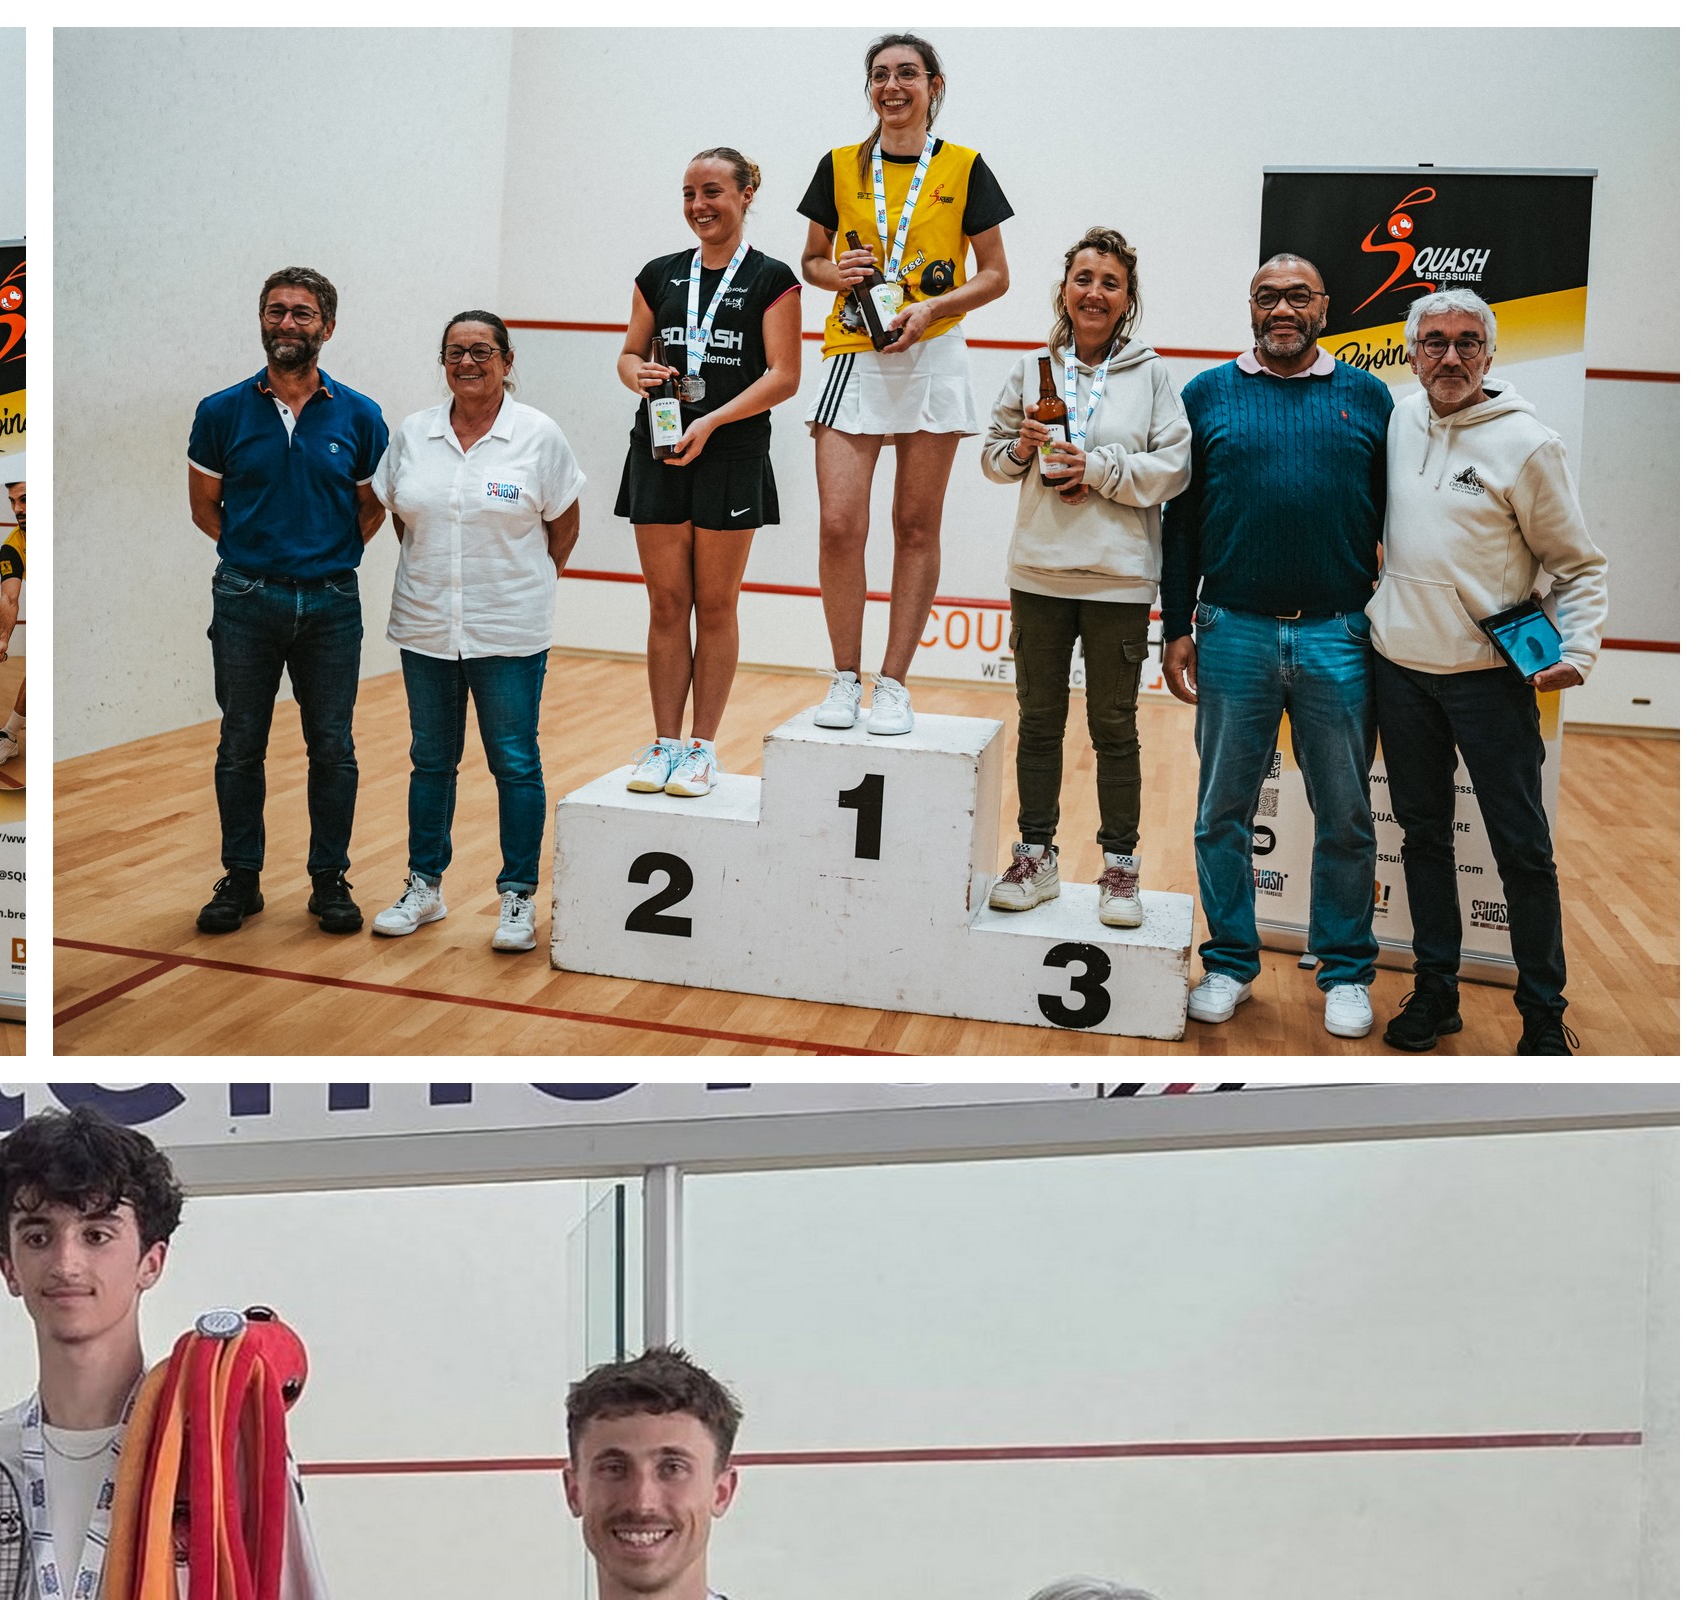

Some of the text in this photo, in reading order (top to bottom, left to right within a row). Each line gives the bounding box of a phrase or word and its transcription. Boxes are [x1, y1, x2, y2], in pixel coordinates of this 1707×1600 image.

[1424, 271, 1482, 282] BRESSUIRE
[1335, 338, 1408, 371] Rejoin
[1448, 481, 1485, 495] CHOUINARD
[981, 663, 1007, 680] WE
[838, 773, 882, 860] 1
[624, 850, 694, 938] 2
[1036, 941, 1113, 1030] 3
